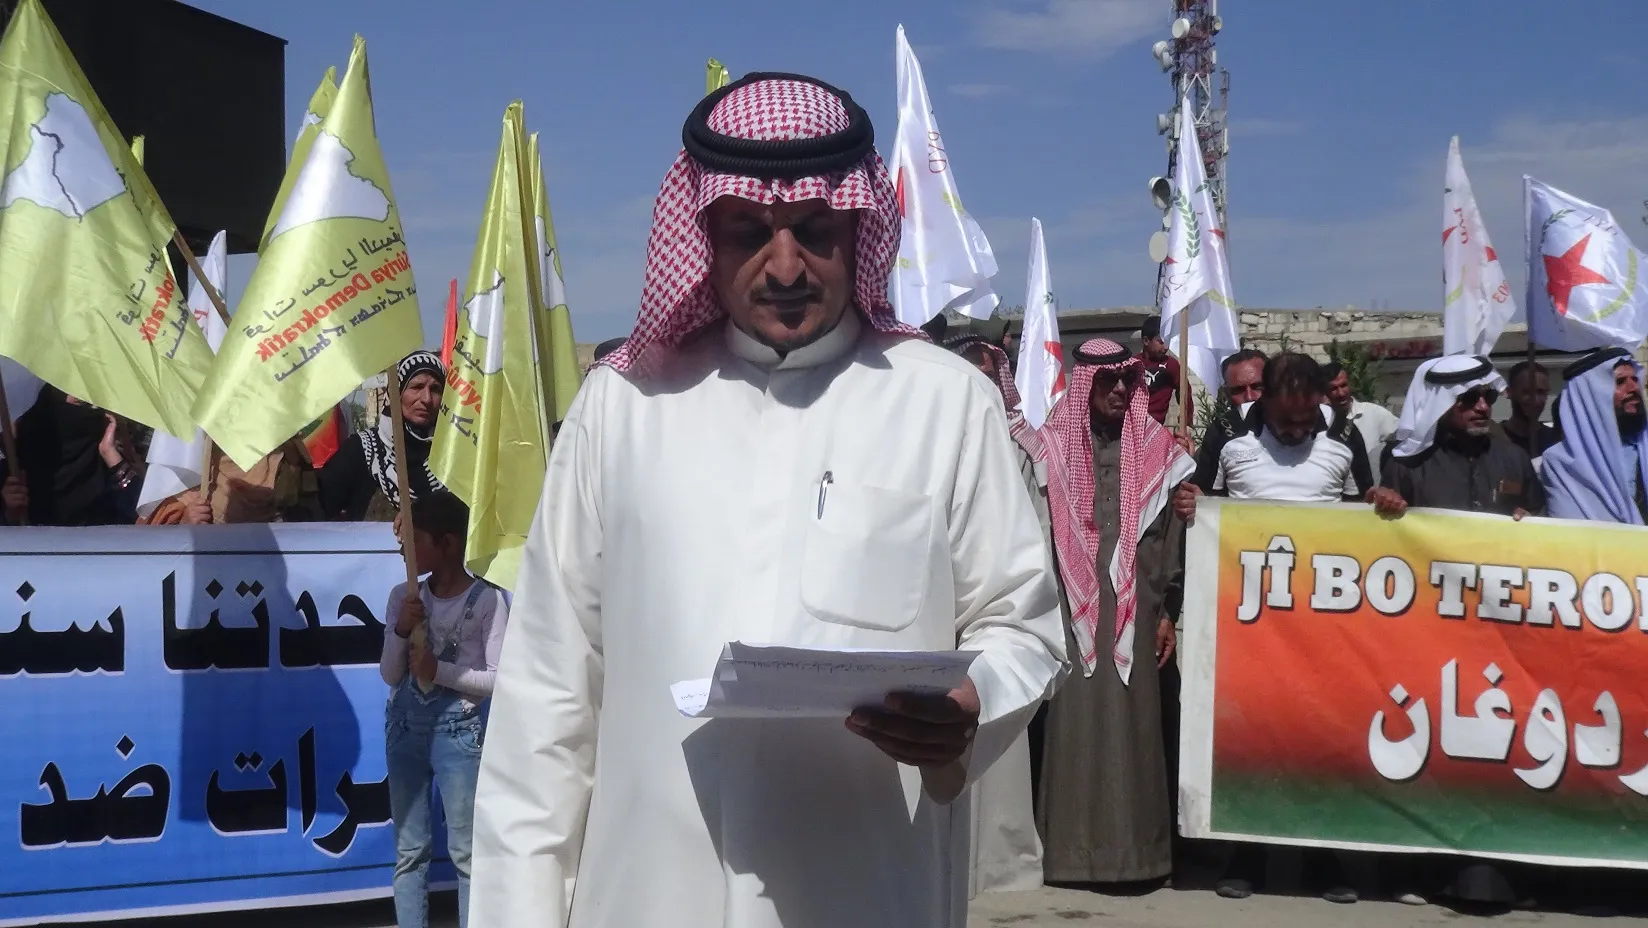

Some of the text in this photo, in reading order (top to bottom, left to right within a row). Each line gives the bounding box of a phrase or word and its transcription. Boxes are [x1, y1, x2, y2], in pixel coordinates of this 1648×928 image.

[0, 570, 387, 676] حدتنا سن
[1236, 534, 1297, 623] JÎ
[1310, 554, 1417, 616] BO
[20, 725, 393, 858] رات ضد
